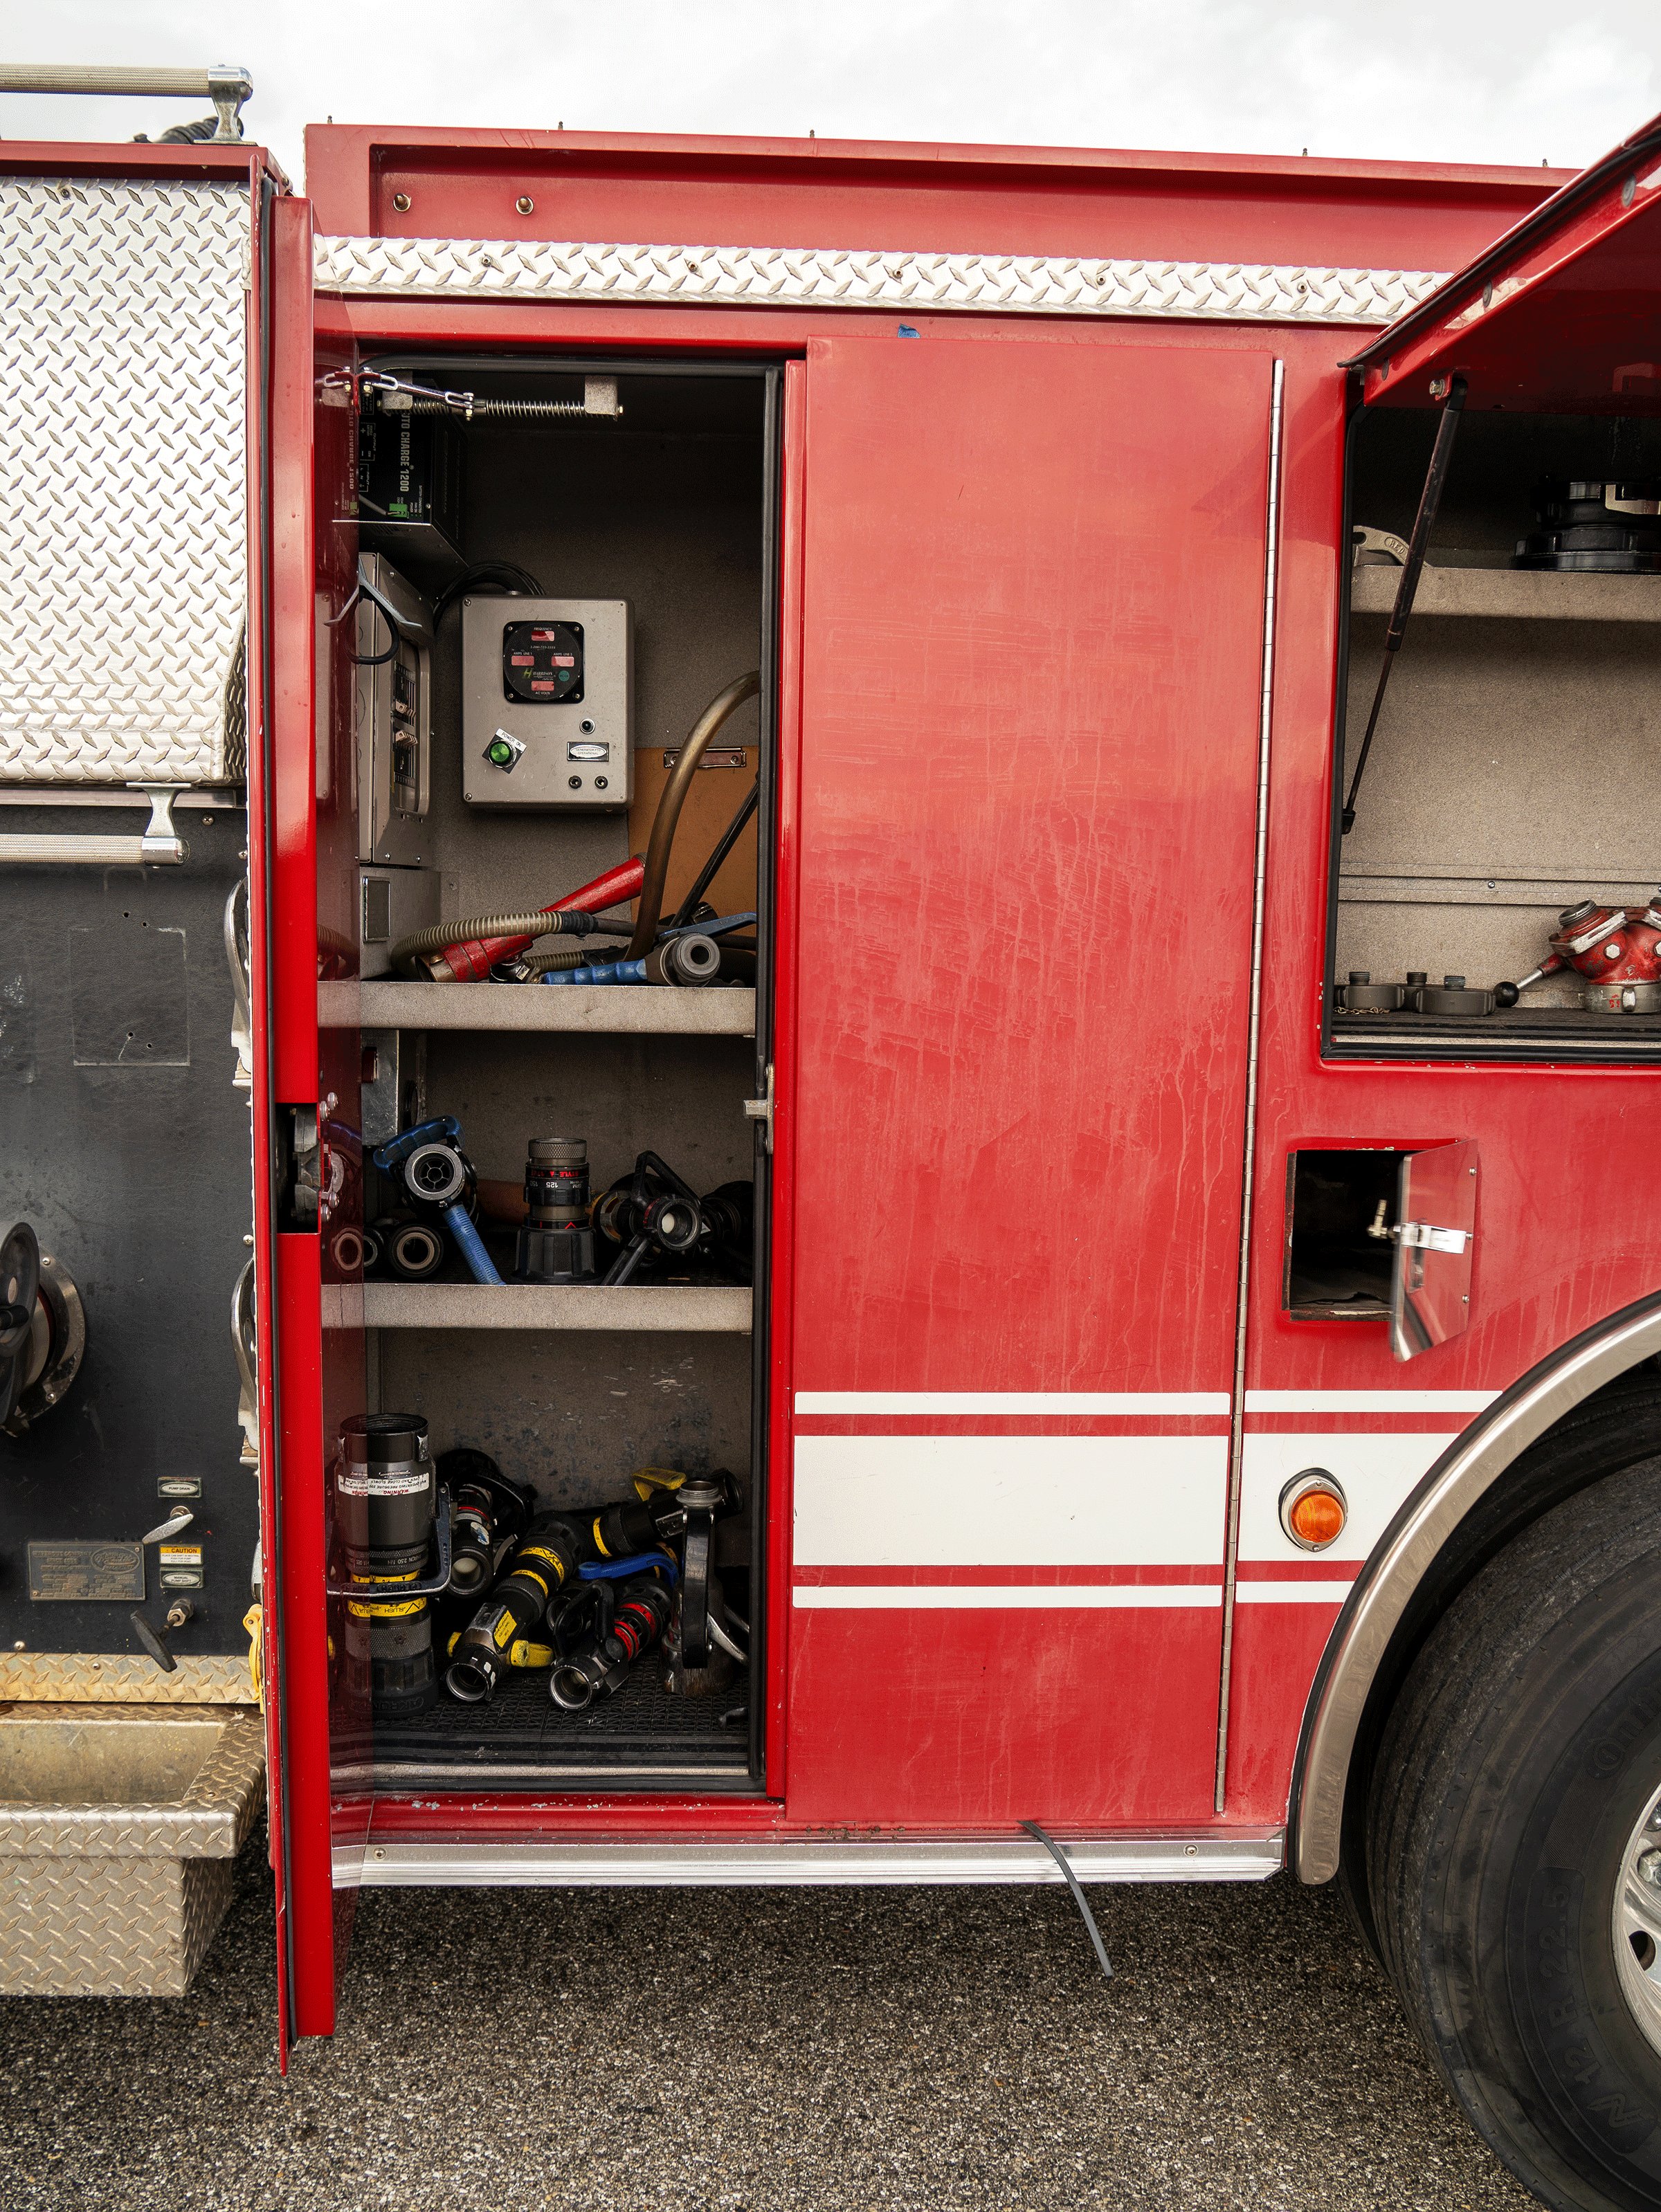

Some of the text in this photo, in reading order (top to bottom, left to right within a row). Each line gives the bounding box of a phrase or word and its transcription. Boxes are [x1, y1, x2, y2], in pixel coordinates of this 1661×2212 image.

[399, 411, 410, 492] UTO CHARGE 1200
[501, 731, 515, 744] POWER
[1538, 1884, 1601, 2085] 12 R 22.5
